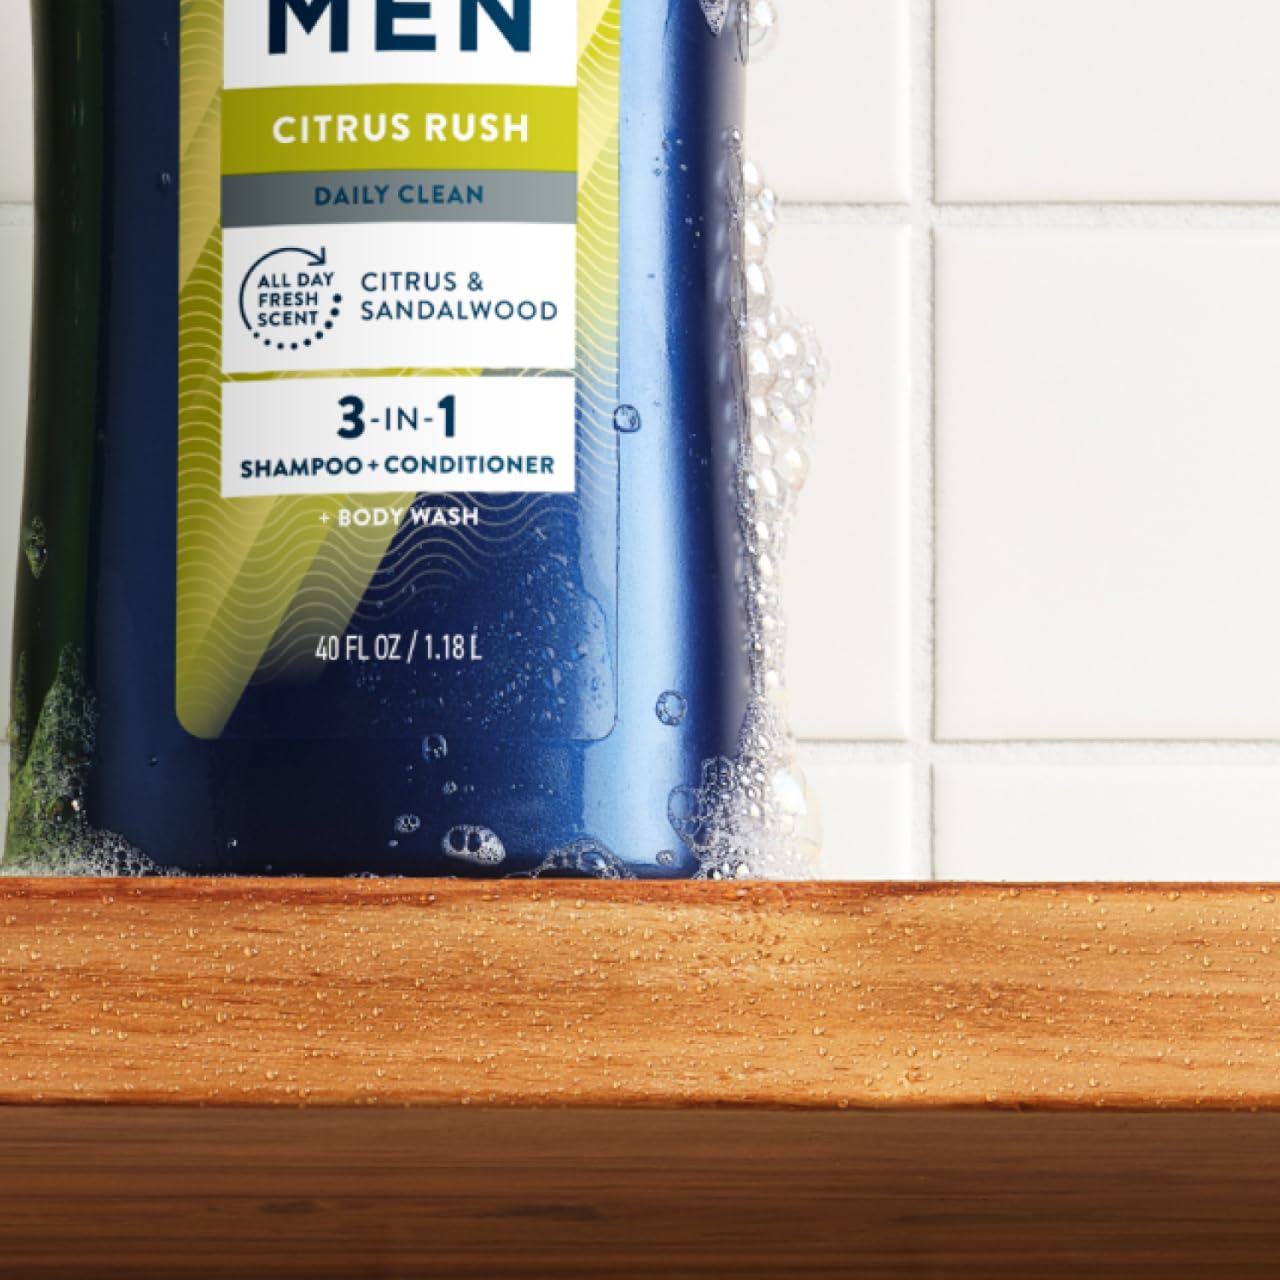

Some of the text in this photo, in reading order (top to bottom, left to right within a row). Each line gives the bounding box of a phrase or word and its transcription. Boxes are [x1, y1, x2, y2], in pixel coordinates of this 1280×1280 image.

[272, 112, 529, 144] CITRUS RUSH
[314, 184, 484, 206] DAILY CLEAN
[257, 271, 335, 288] ALL DAY
[361, 271, 484, 292] CITRUS &
[258, 291, 319, 308] FRESH
[258, 310, 319, 327] SCENT
[361, 300, 558, 321] SANDALWOOD
[337, 394, 456, 439] 3-IN-1
[240, 456, 363, 479] SHAMPOO
[384, 455, 555, 475] CONDITIONER
[338, 508, 403, 527] BODY
[409, 507, 480, 526] WASH
[315, 634, 340, 660] 40
[346, 634, 370, 660] FL
[374, 633, 401, 660] OZ
[425, 633, 466, 660] 1.18
[470, 633, 483, 661] L
